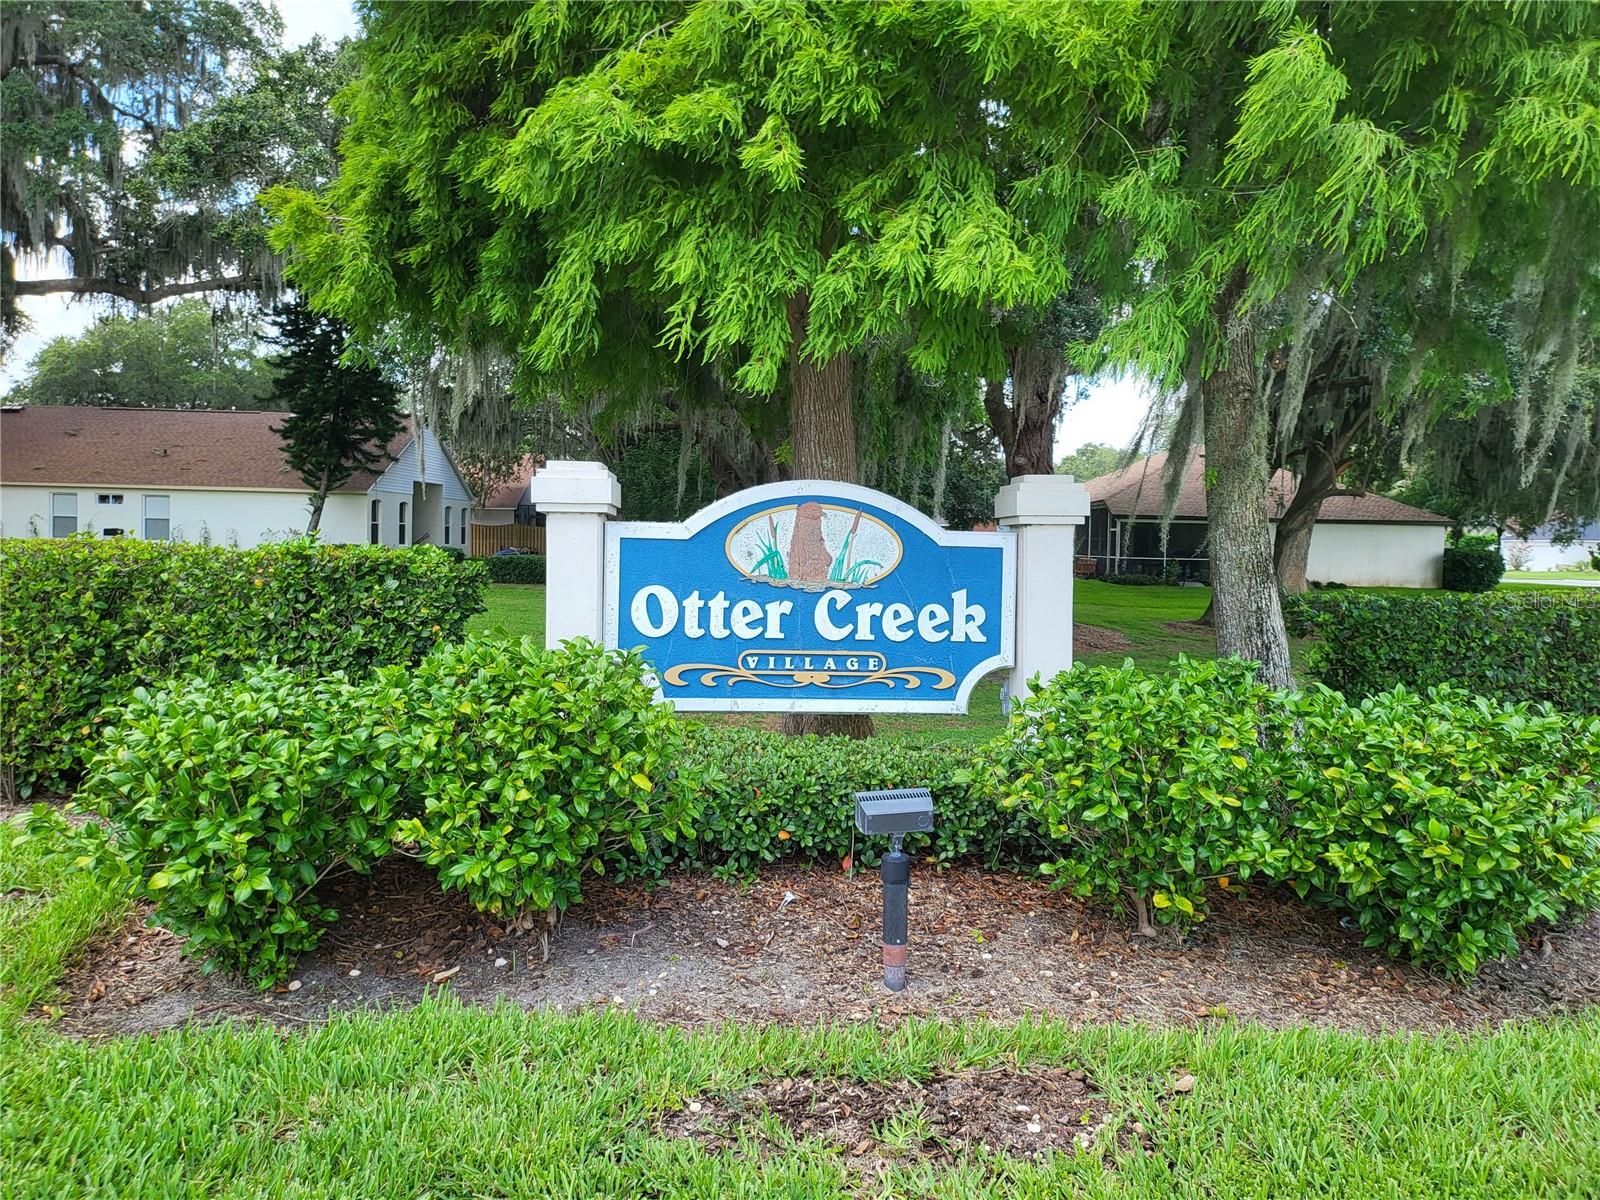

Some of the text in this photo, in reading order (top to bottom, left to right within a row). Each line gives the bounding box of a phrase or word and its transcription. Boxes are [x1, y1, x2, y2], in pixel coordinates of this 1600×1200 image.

[630, 584, 987, 642] Otter Creek
[746, 656, 879, 670] VILLAGE
